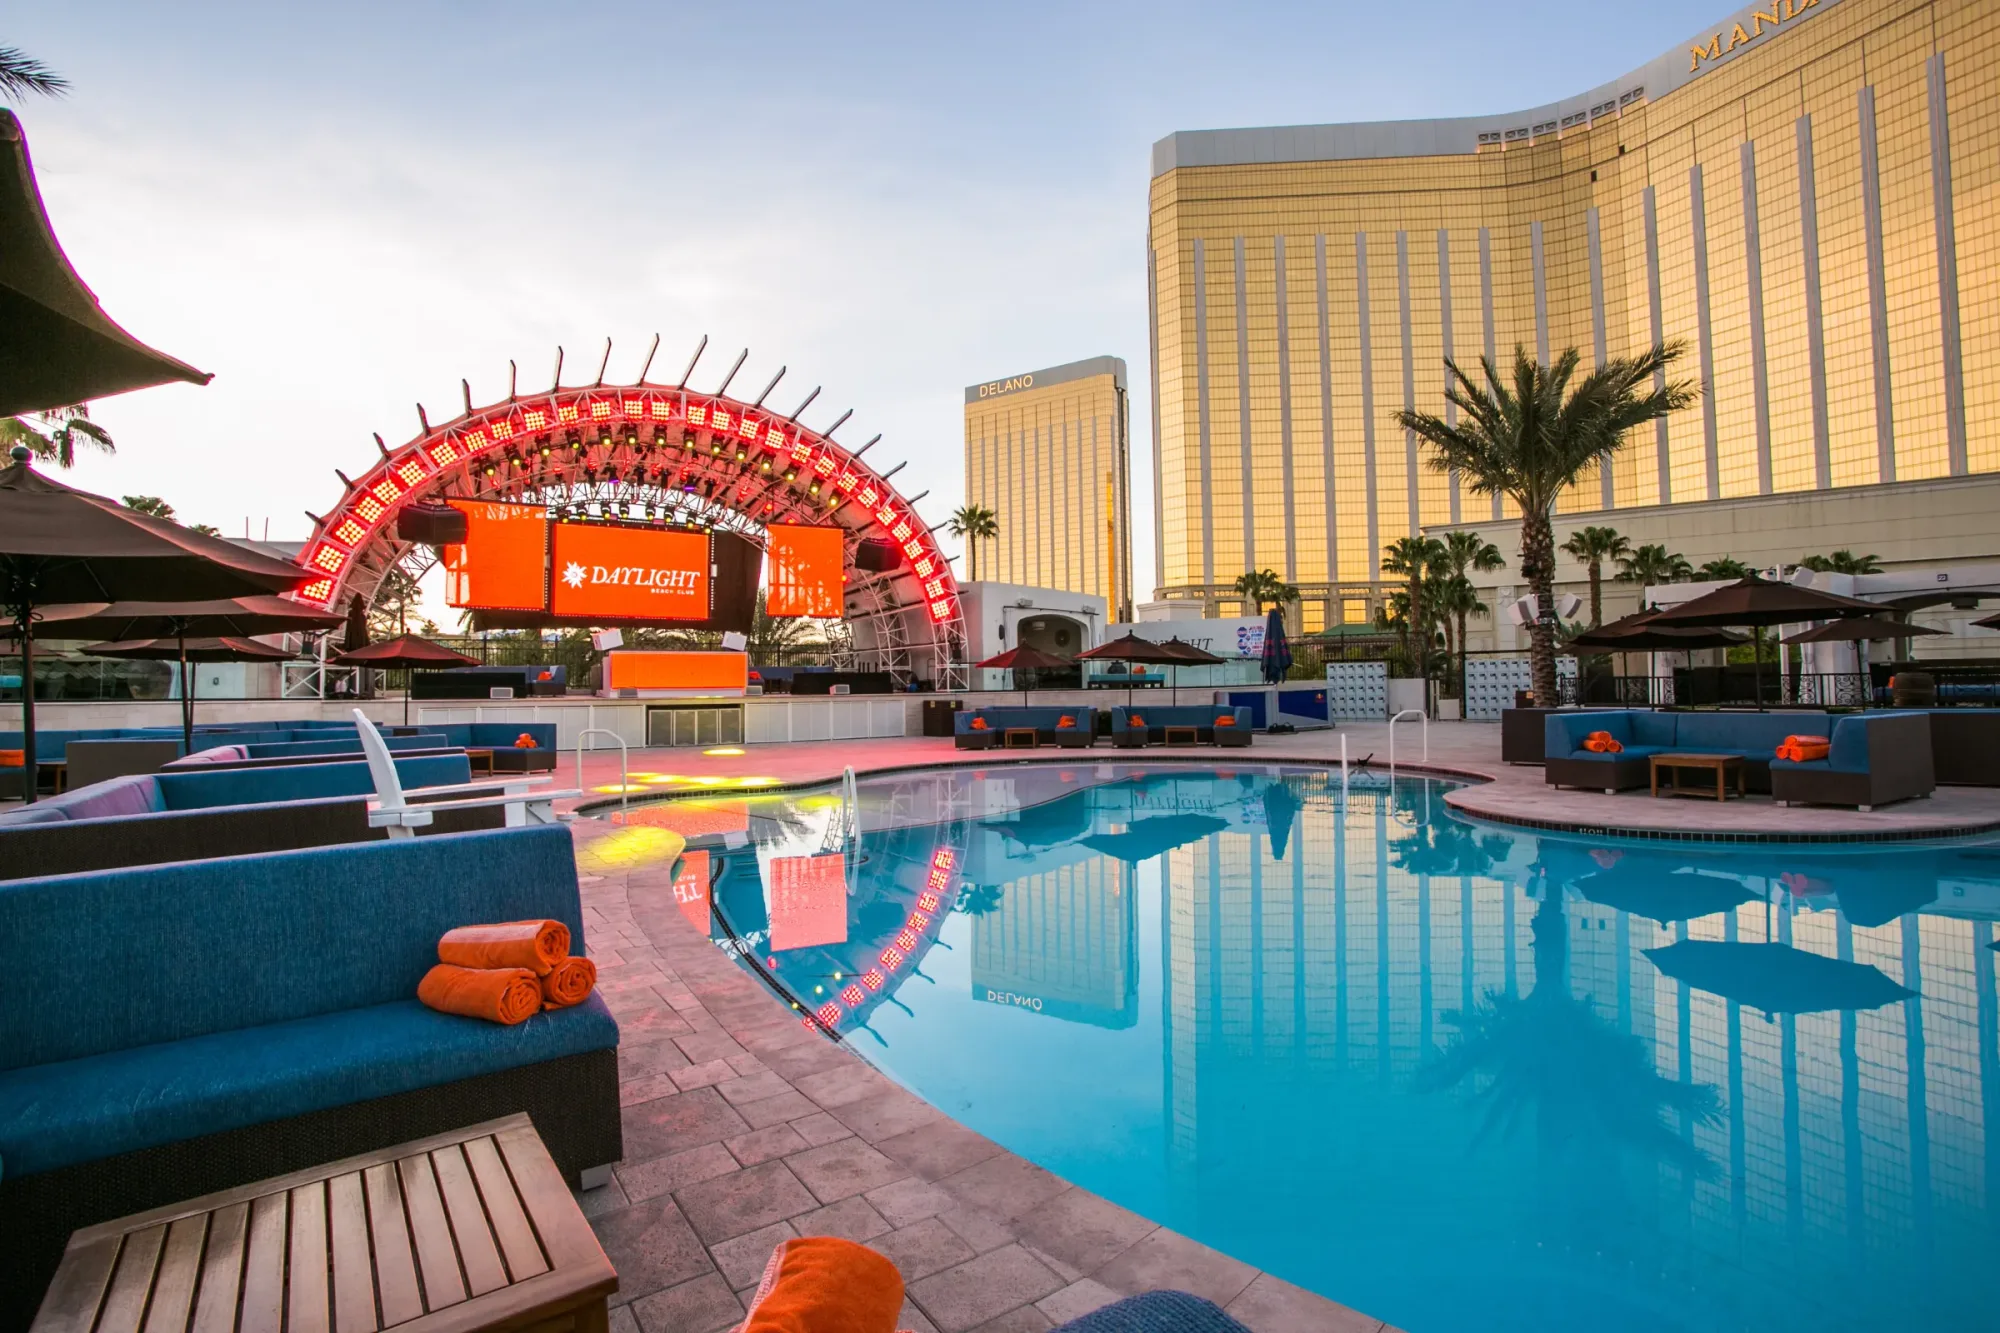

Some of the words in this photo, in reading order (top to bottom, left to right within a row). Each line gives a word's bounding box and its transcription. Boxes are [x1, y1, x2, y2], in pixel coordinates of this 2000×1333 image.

[1689, 0, 1819, 73] MAND
[979, 374, 1033, 398] DELANO
[590, 566, 700, 588] DAYLIGHT
